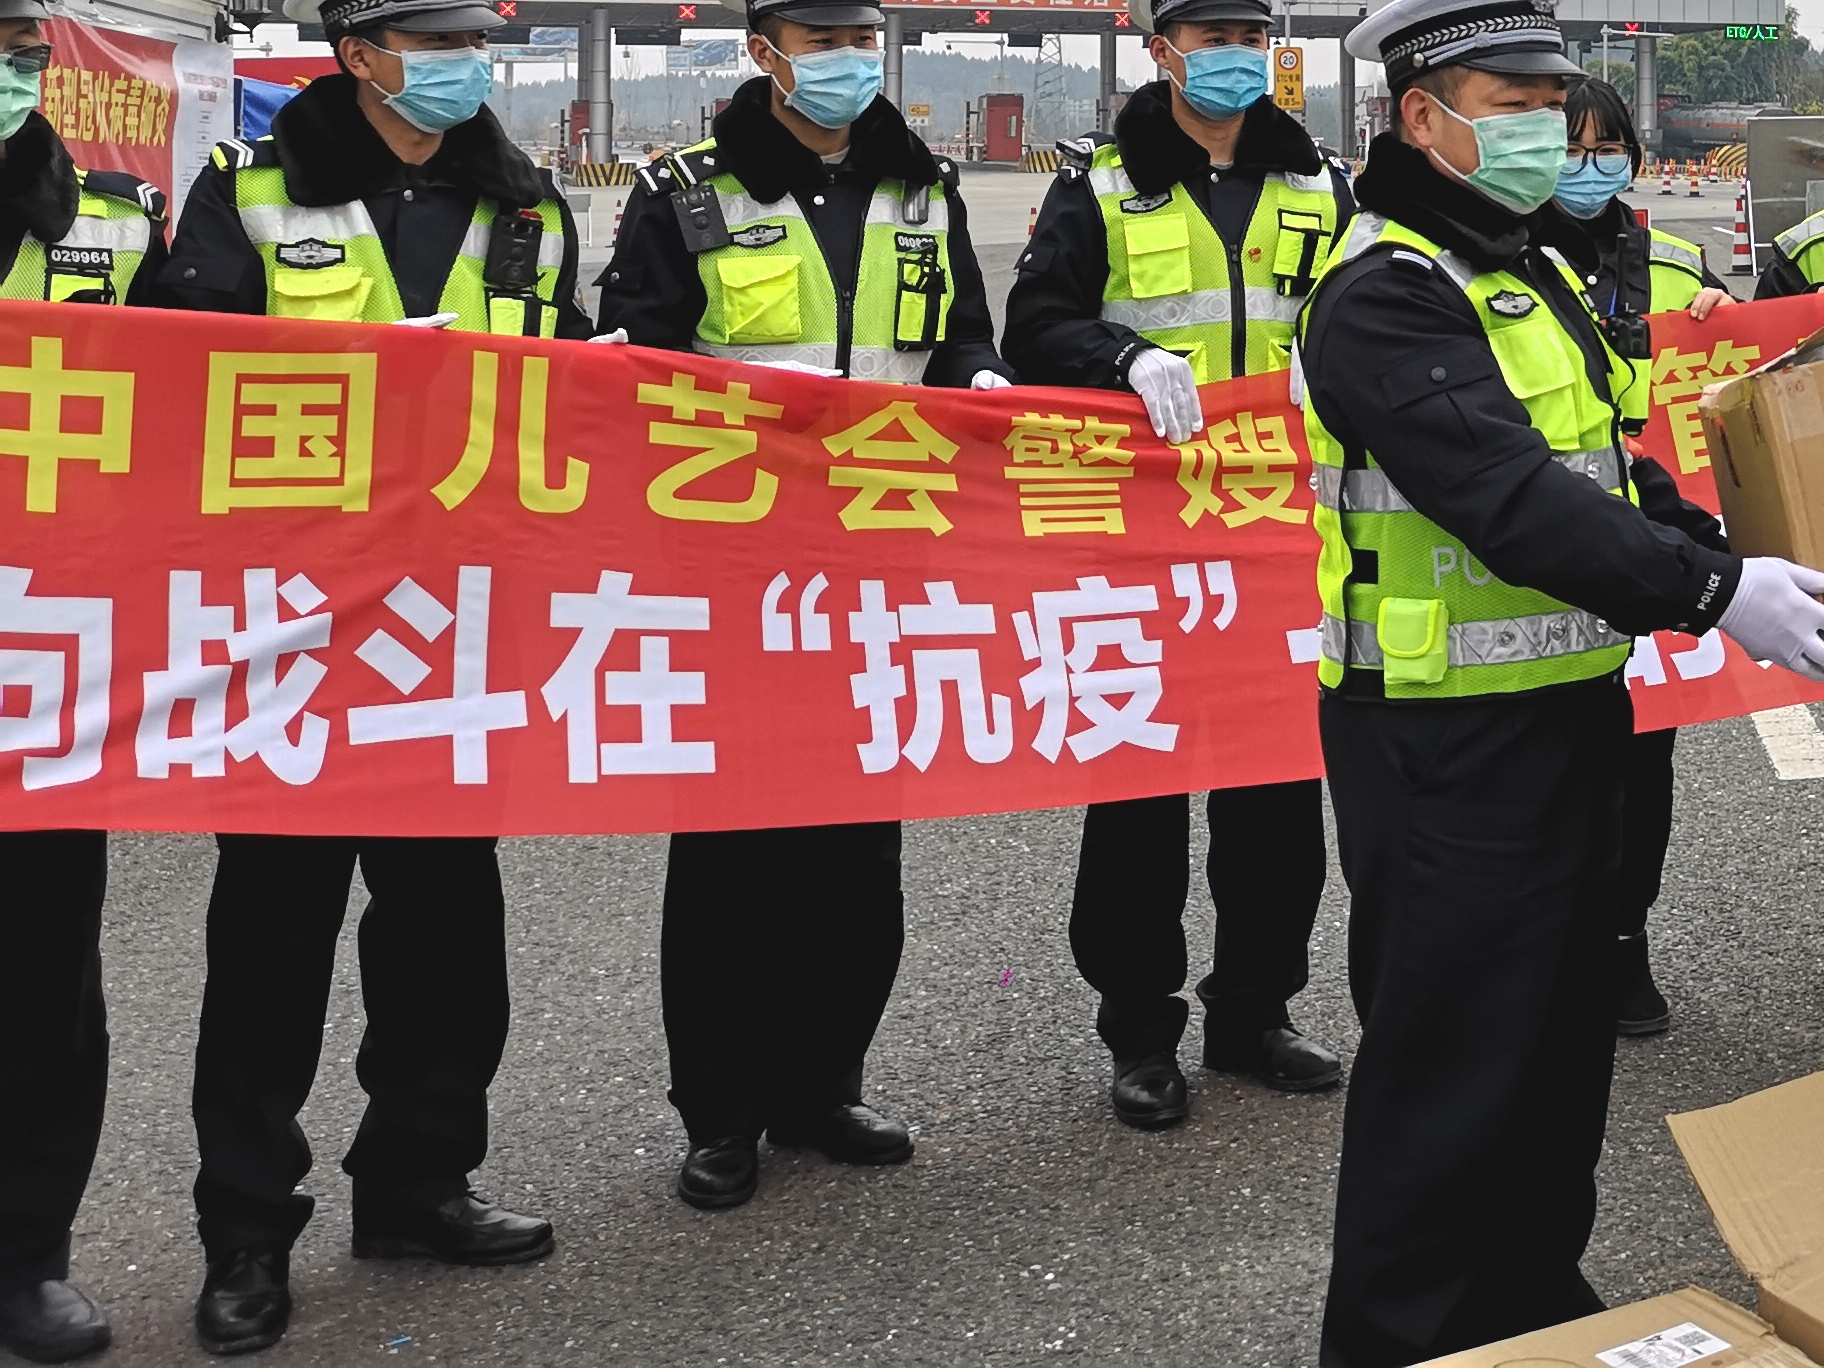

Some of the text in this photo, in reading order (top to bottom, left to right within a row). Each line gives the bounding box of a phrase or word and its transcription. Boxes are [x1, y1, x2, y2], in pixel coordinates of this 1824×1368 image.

[1726, 25, 1778, 41] ETC/人工
[1283, 56, 1294, 65] 20
[1697, 571, 1722, 611] POLICE
[0, 559, 1320, 791] 向战斗在“抗疫”
